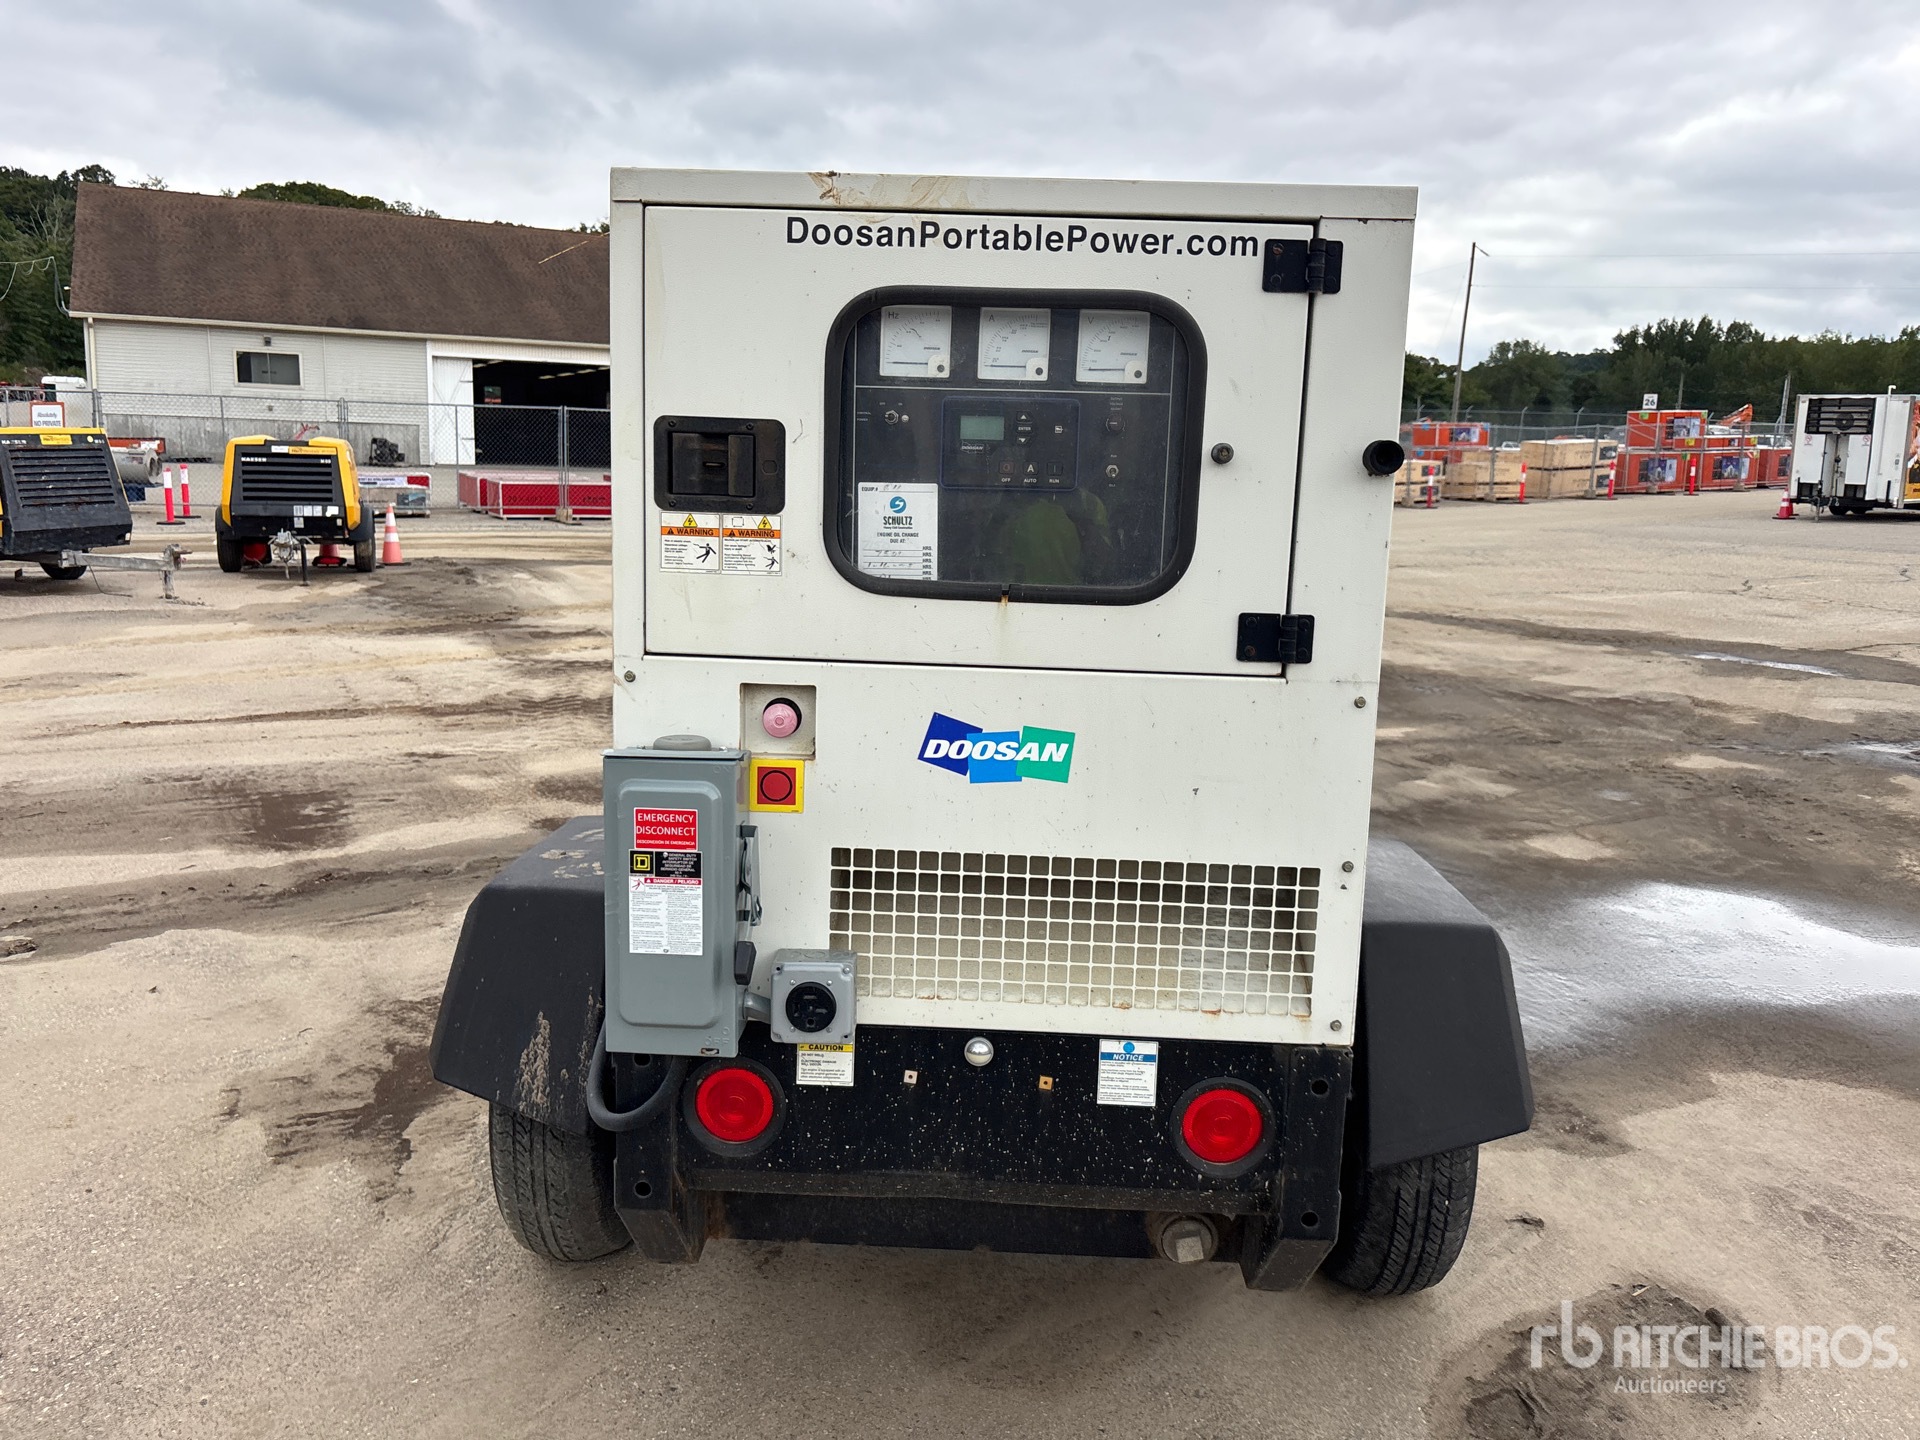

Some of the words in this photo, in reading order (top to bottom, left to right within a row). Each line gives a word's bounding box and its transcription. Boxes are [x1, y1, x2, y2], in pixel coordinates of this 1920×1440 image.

[786, 216, 1259, 257] DoosanPortablePower.com
[888, 311, 899, 319] Hz
[989, 314, 995, 322] A
[1088, 316, 1094, 324] V
[883, 516, 912, 525] SCHULTZ
[923, 739, 1069, 762] DOOSAN
[637, 813, 694, 823] EMERGENCY
[636, 826, 695, 835] DISCONNECT
[636, 857, 648, 868] D
